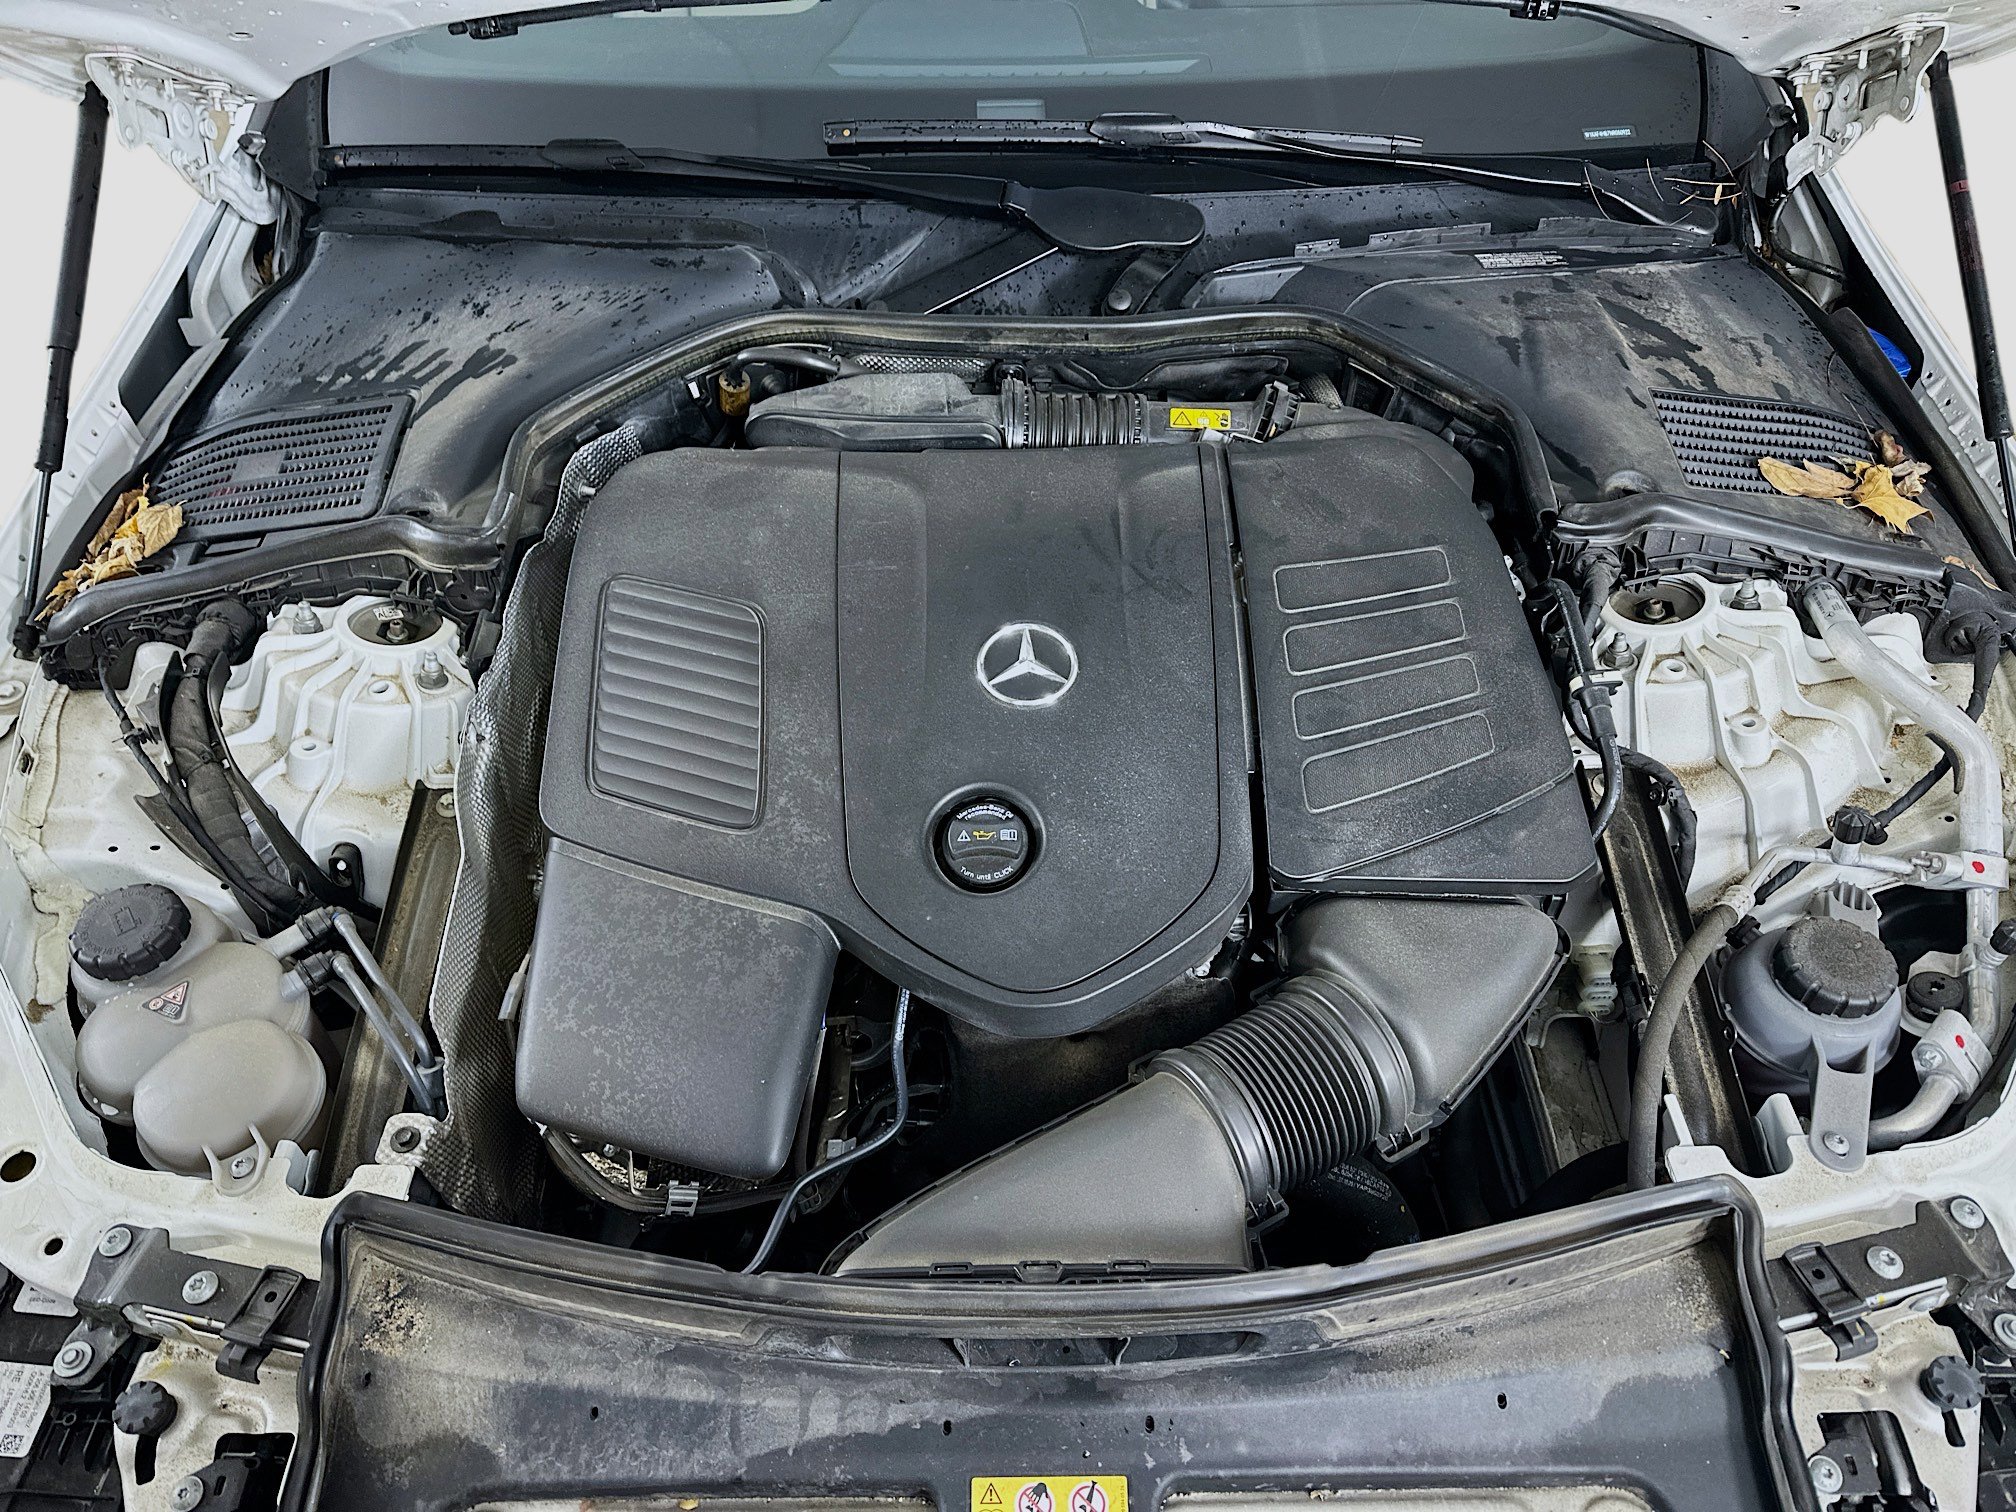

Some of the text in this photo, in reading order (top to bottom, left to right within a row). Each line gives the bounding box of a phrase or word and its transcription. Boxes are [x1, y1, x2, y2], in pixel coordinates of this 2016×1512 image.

[957, 804, 1005, 820] Mercedes-Benz
[964, 809, 1007, 820] recommended
[960, 866, 975, 878] Turn
[993, 865, 1014, 879] CLICK
